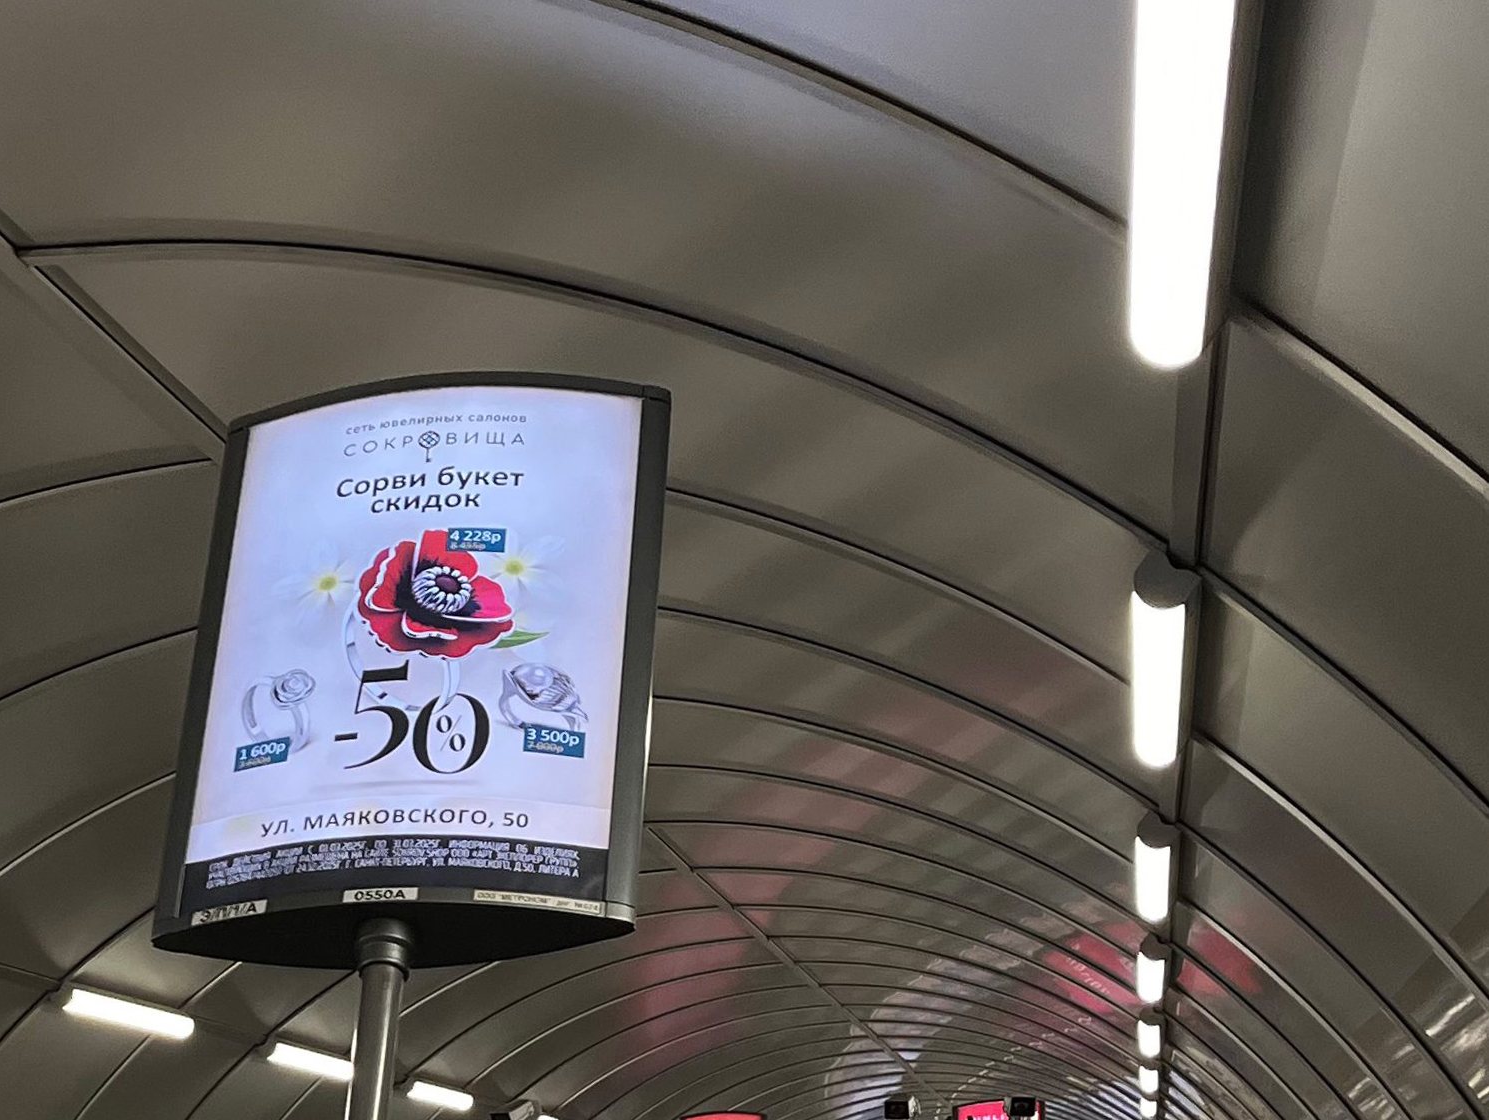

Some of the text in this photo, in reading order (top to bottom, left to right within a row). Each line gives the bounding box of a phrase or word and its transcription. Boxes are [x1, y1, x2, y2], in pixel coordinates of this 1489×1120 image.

[345, 413, 527, 436] сеть ювелирных салонов
[336, 466, 525, 498] Сорви букет
[370, 493, 481, 514] скидок
[449, 530, 502, 545] 4 228р
[526, 728, 580, 747] 3 500р
[239, 742, 287, 761] 1 600р
[261, 808, 529, 838] УЛ. МАЯКОВСКОГО, 50
